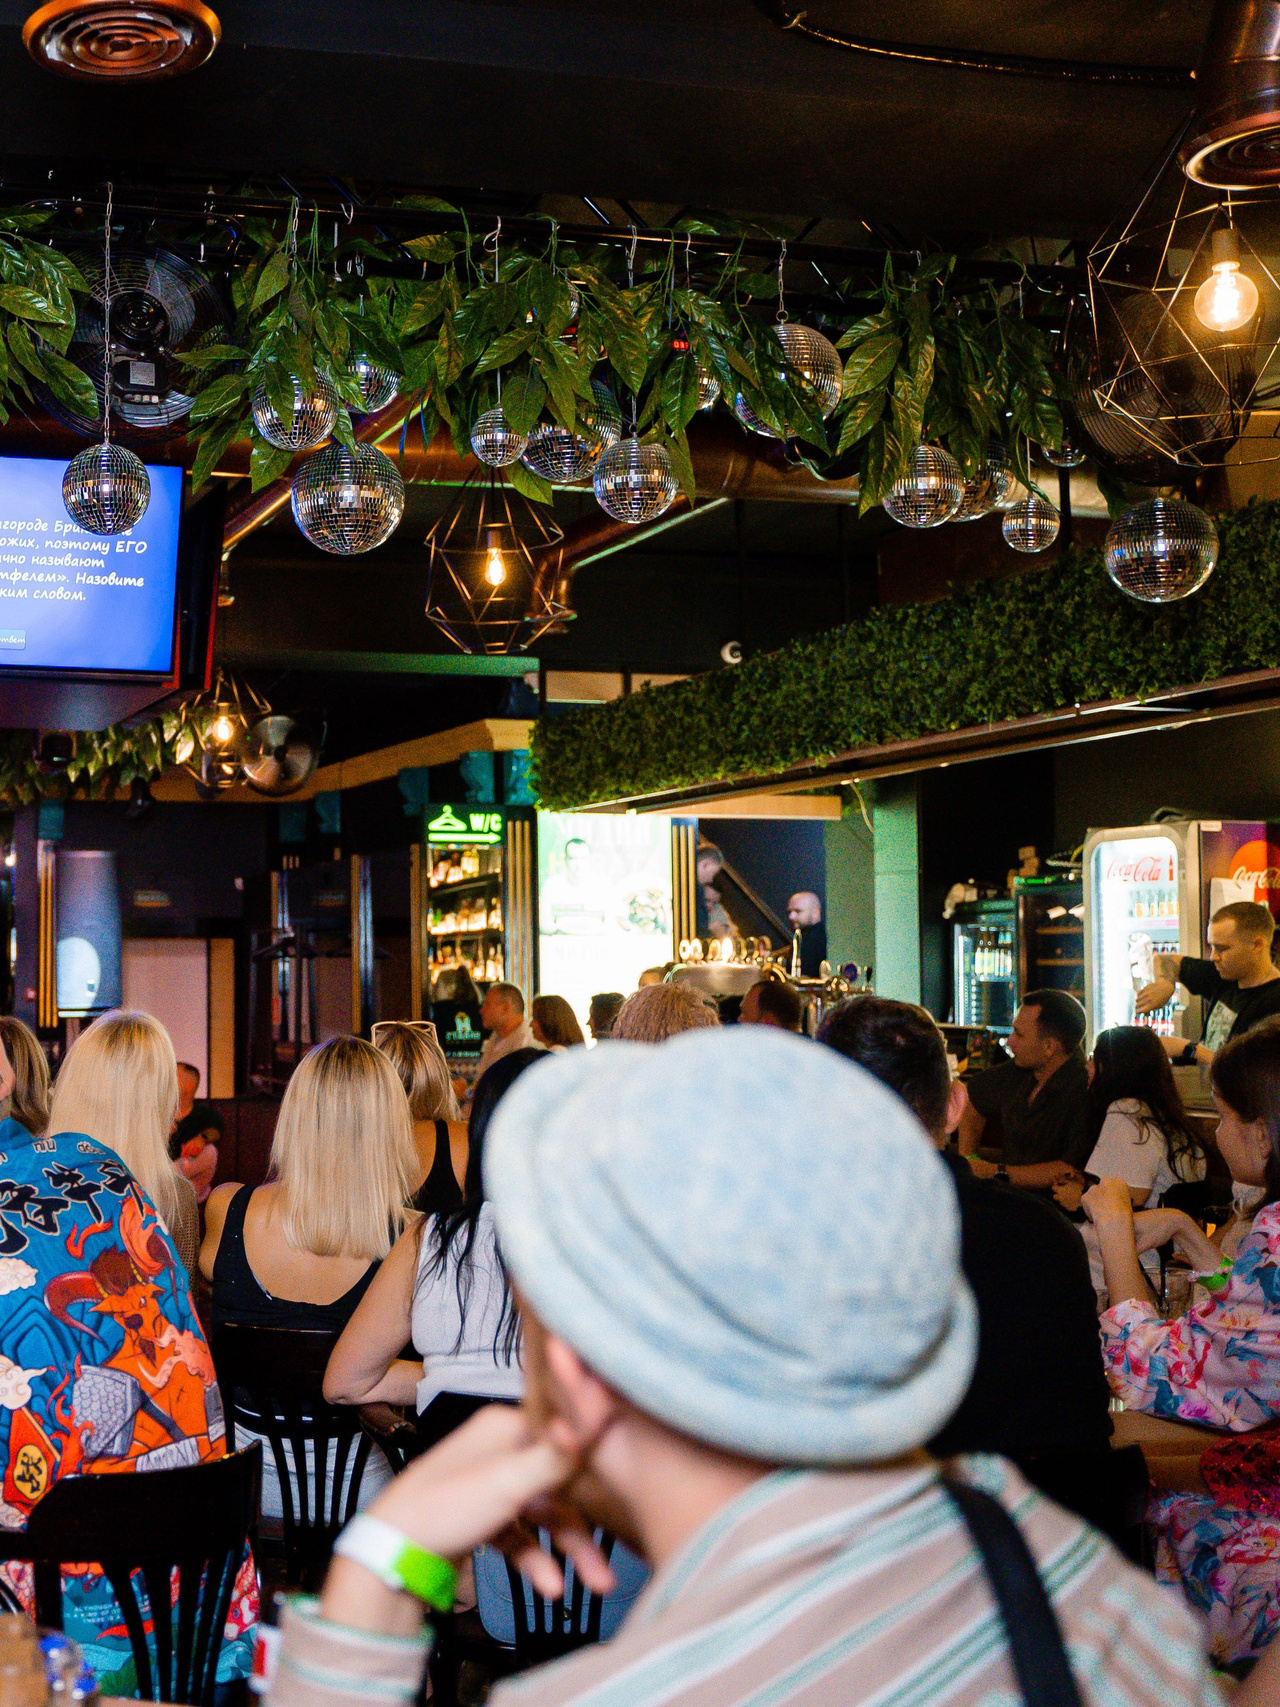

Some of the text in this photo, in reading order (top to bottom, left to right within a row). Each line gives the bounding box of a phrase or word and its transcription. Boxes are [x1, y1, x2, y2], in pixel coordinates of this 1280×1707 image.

[45, 540, 110, 555] поэтому
[115, 540, 148, 554] ЕГО
[31, 552, 105, 568] называют
[75, 571, 144, 587] Назовите
[33, 586, 87, 601] словом.
[469, 813, 502, 833] W/C
